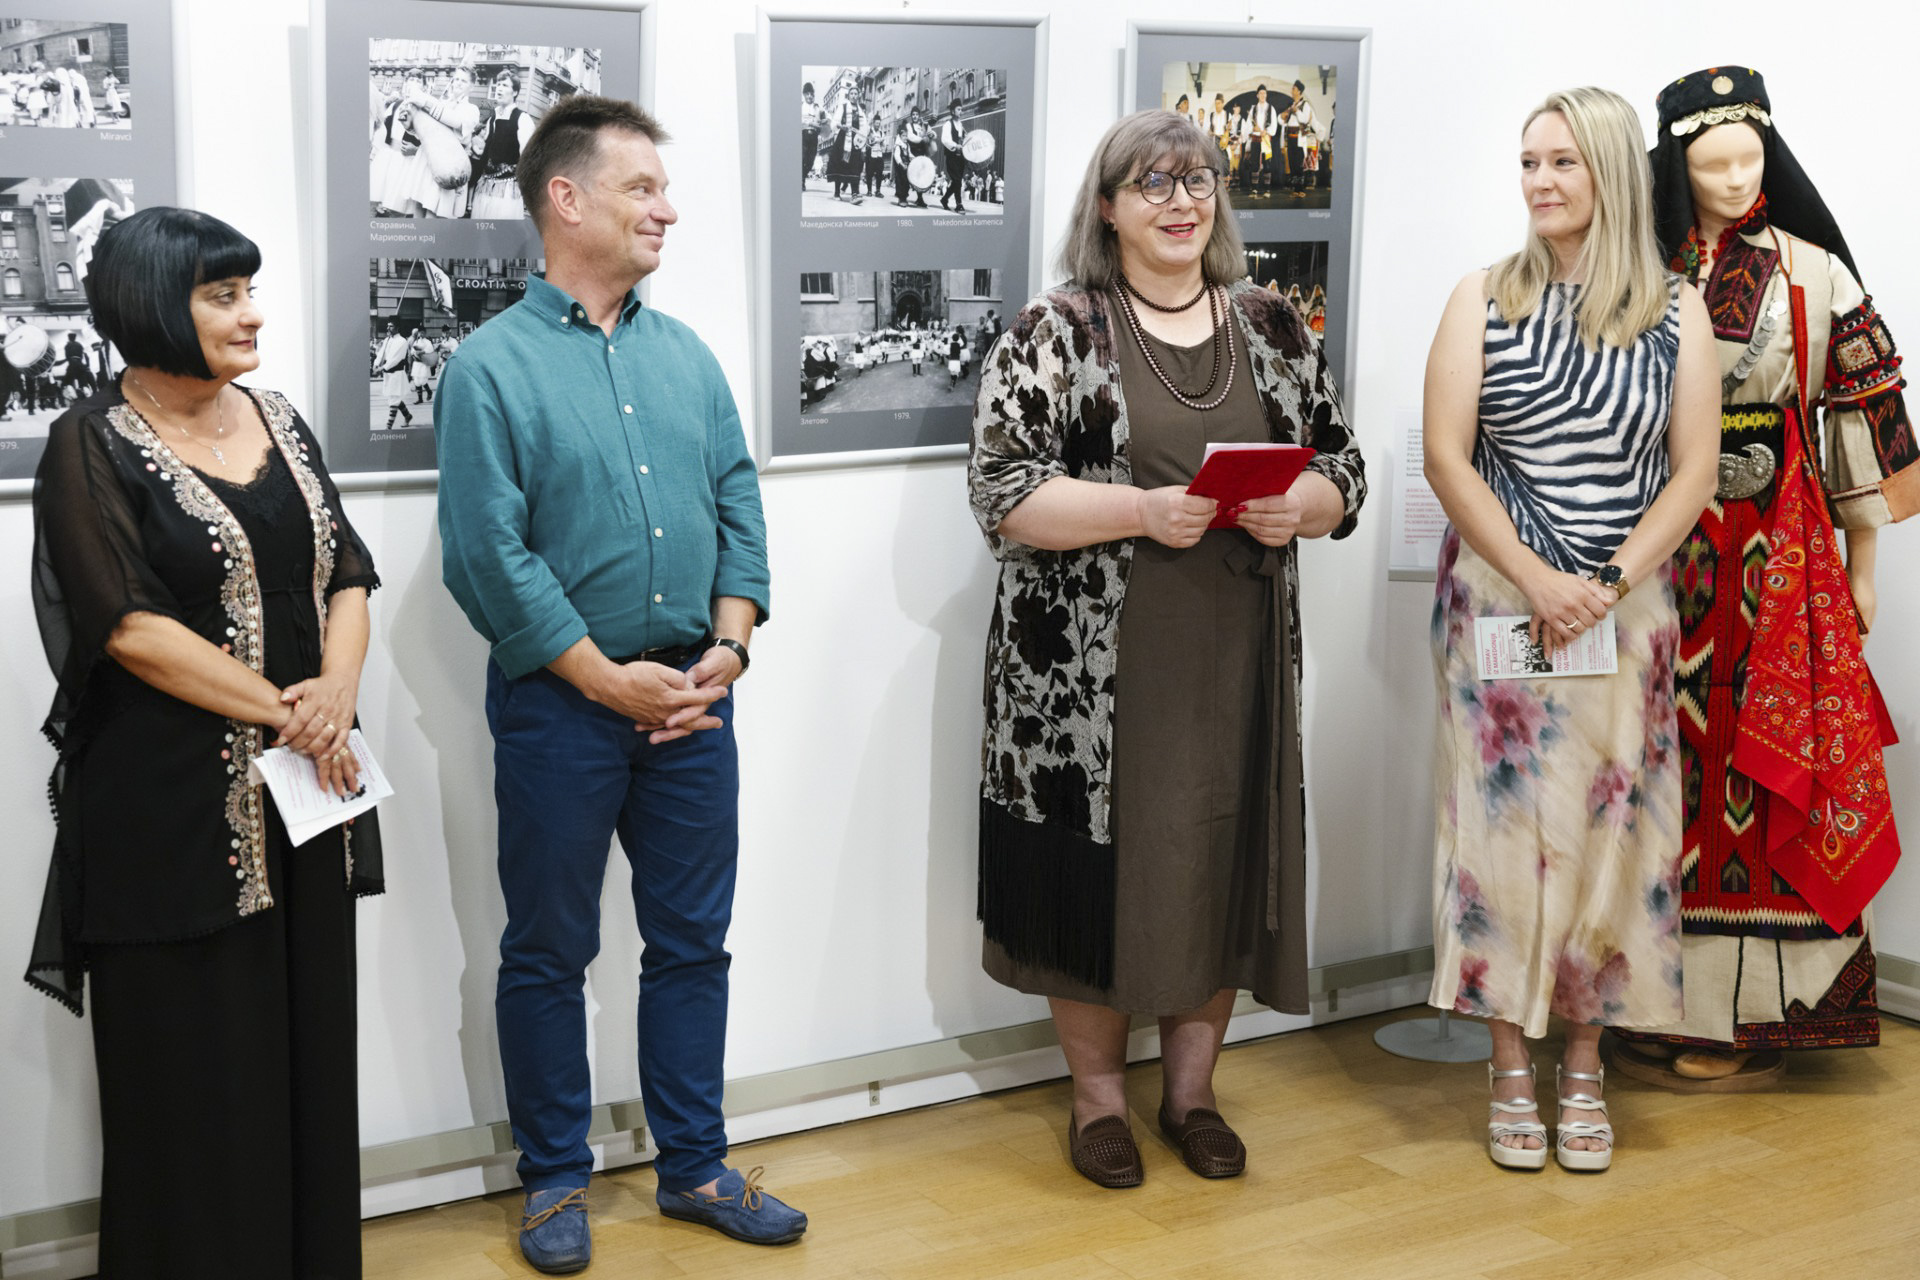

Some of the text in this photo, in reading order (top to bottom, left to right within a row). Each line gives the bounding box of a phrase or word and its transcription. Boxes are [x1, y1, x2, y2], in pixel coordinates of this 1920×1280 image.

[100, 132, 132, 141] Miravci
[370, 221, 416, 231] Старавина,
[475, 222, 496, 231] 1974.
[800, 219, 879, 229] Македонска Каменица
[897, 219, 914, 227] 1980.
[933, 218, 1004, 227] Makedonska Kamenica
[370, 233, 436, 244] Мариовски крај
[456, 279, 507, 290] CROATIA
[894, 412, 911, 420] 1979.
[370, 433, 407, 442] Долнени
